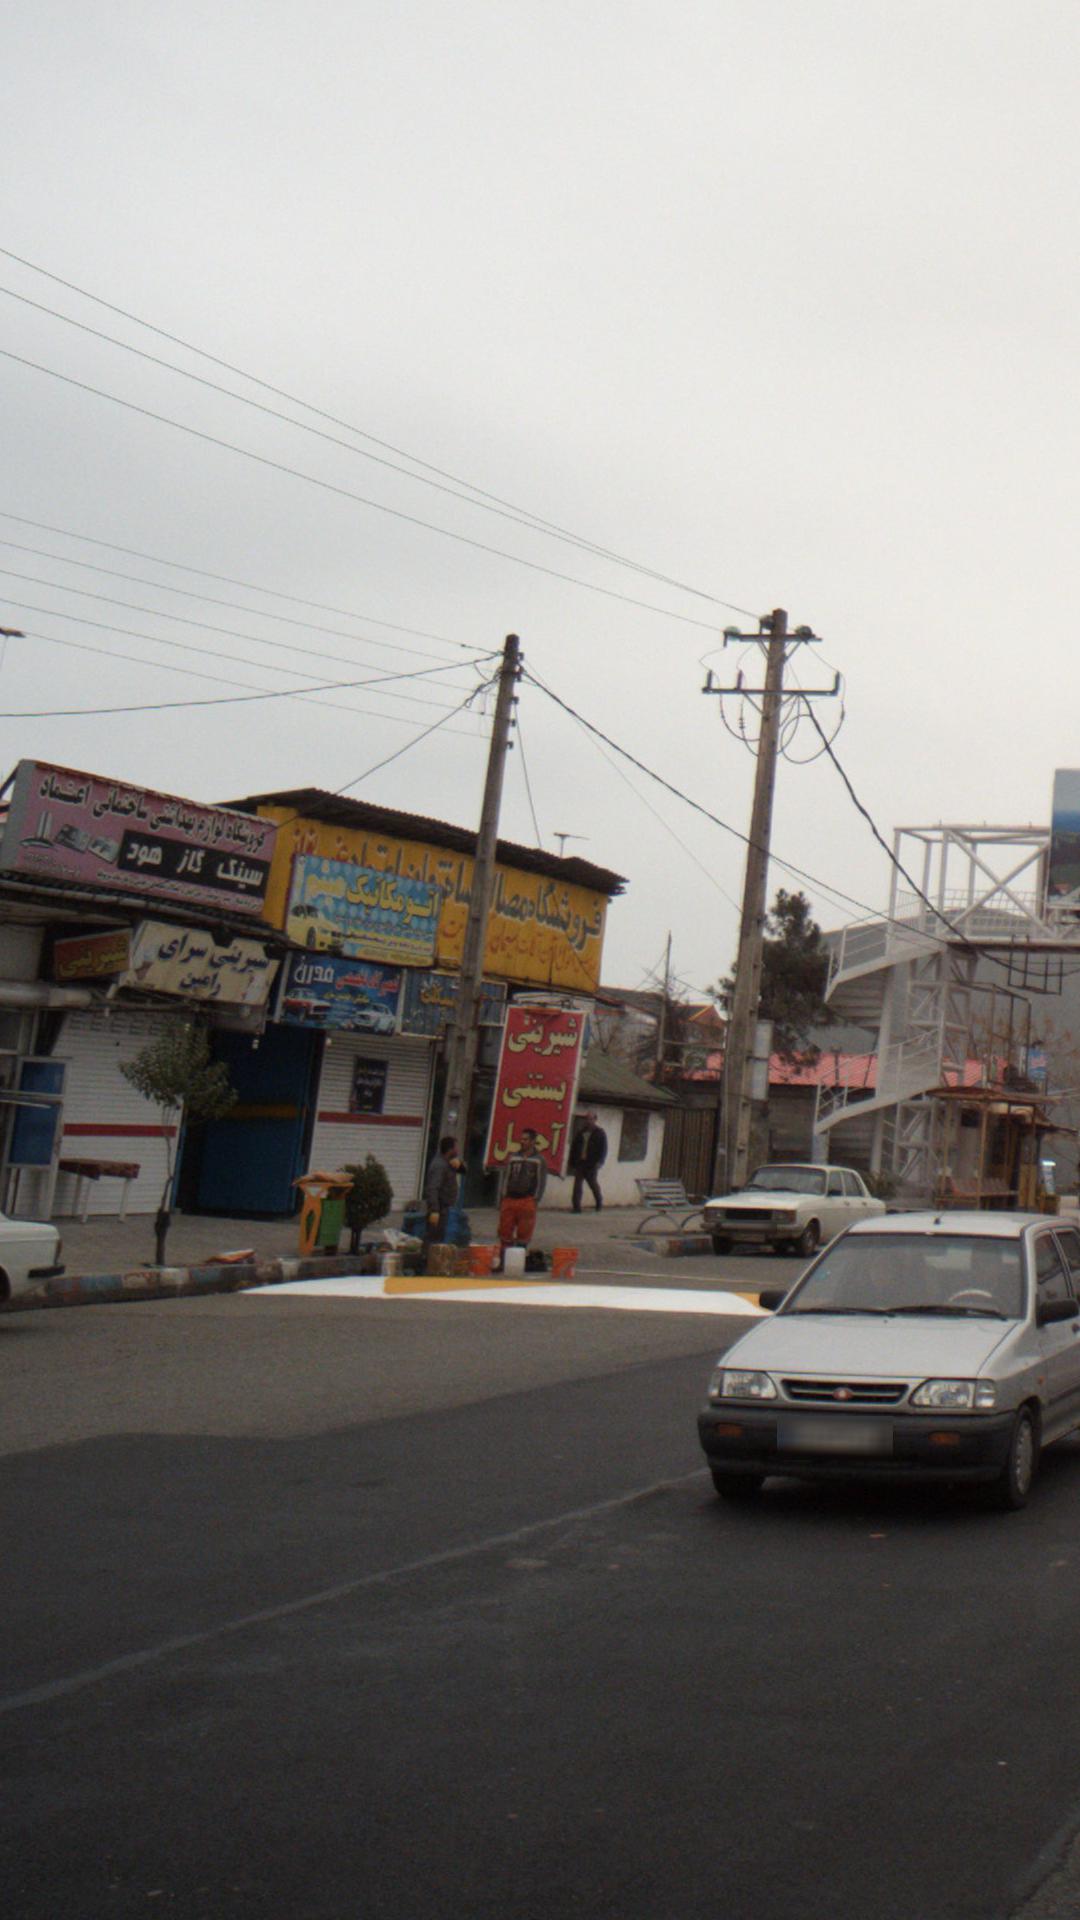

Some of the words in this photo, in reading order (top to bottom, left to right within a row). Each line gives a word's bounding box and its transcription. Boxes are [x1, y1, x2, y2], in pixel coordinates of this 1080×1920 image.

[126, 843, 163, 866] هود
[176, 849, 206, 873] گاز
[216, 858, 264, 889] سینک
[508, 1014, 578, 1056] شیرینی
[502, 1072, 567, 1111] بستنی
[493, 1121, 565, 1161] آجل
